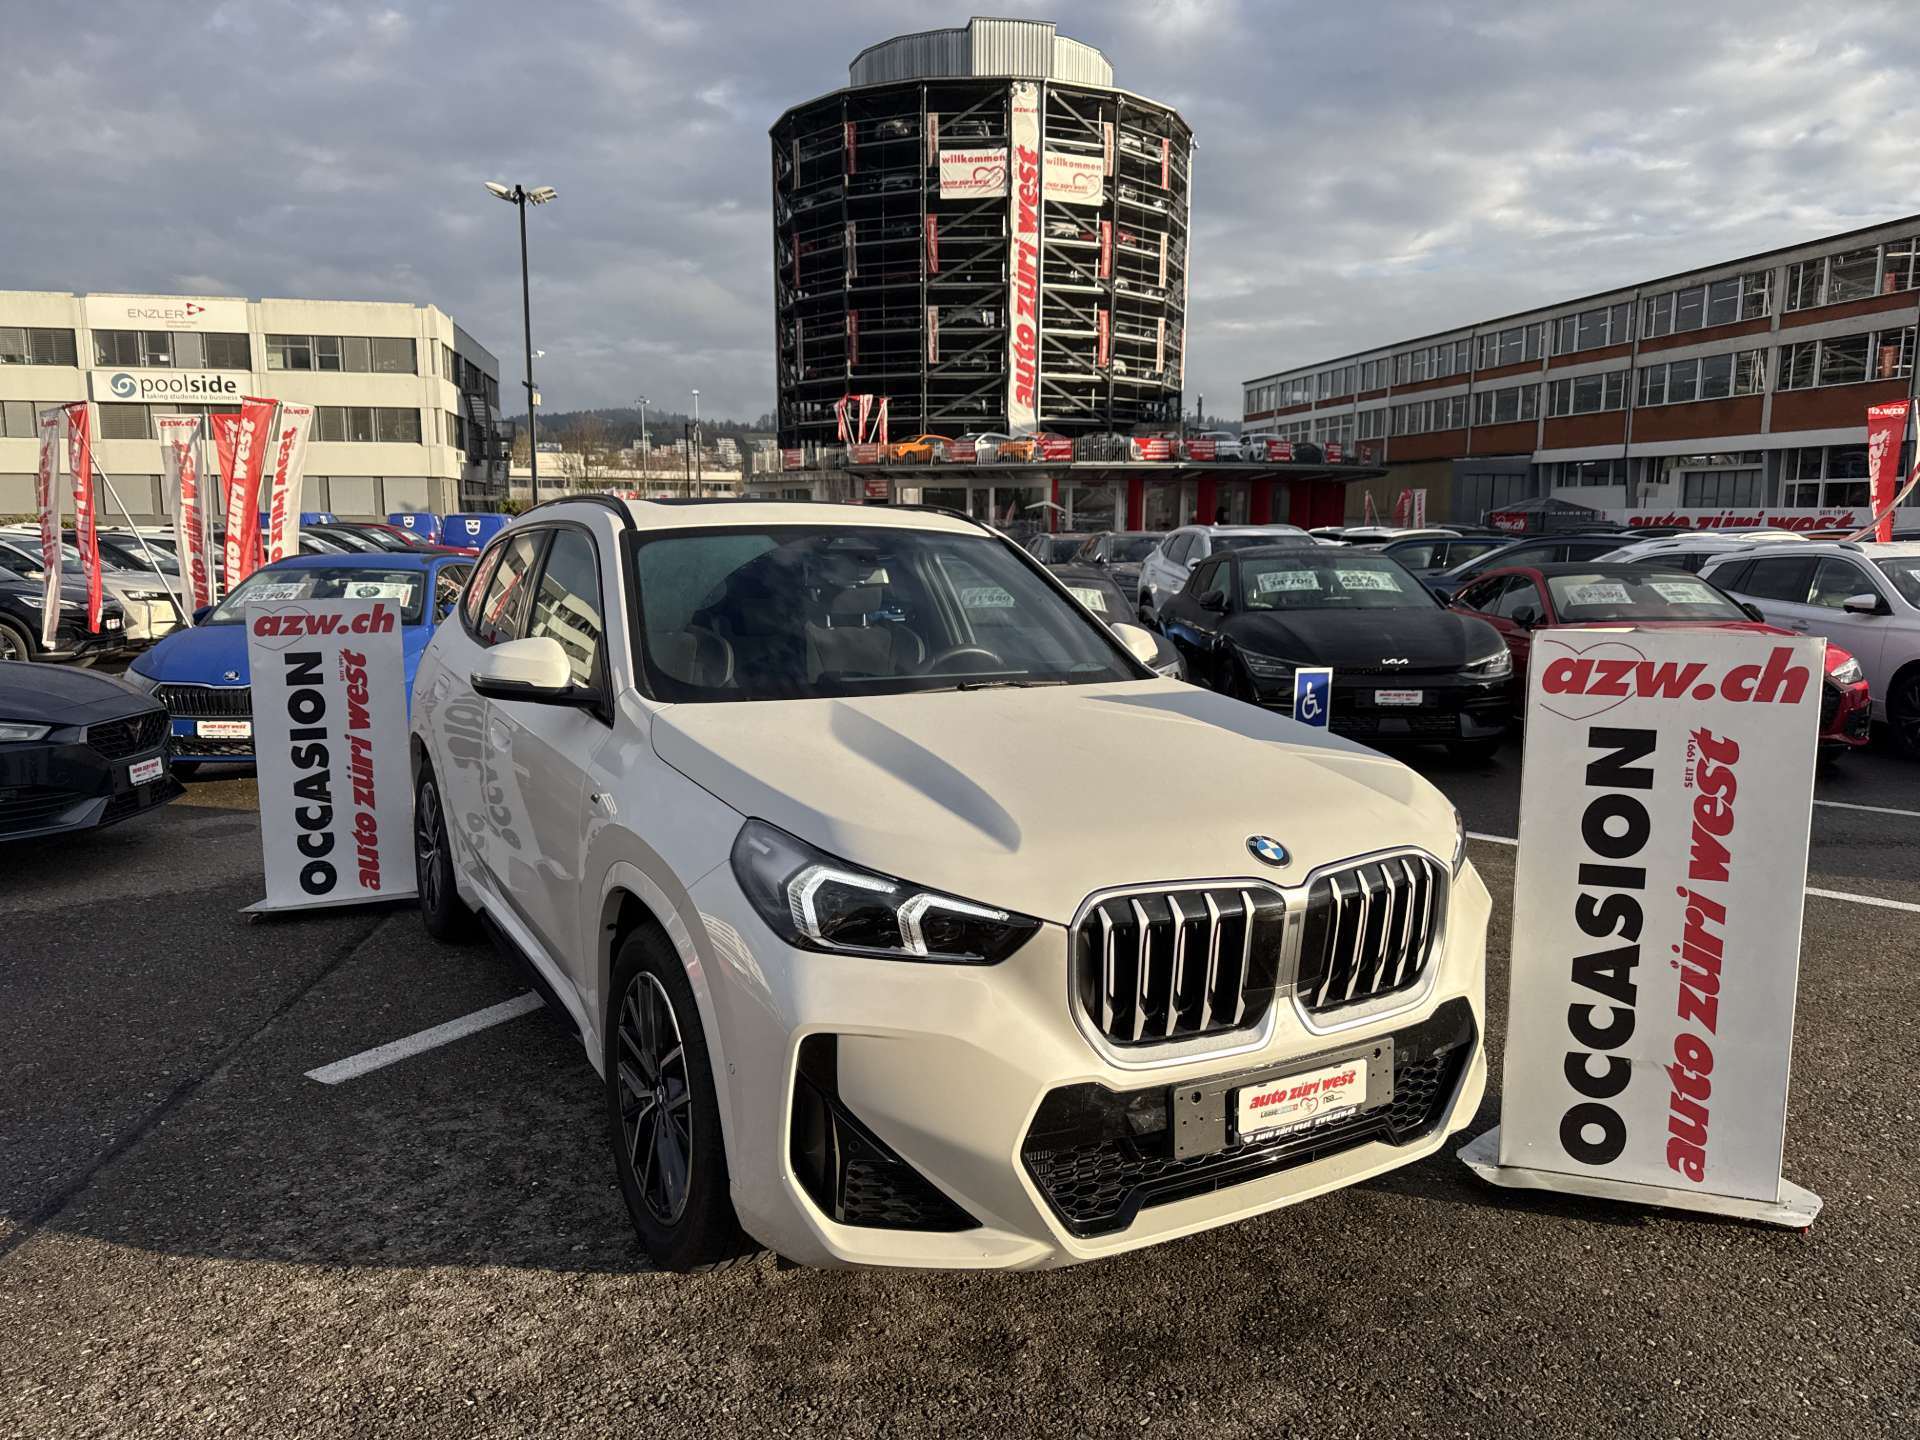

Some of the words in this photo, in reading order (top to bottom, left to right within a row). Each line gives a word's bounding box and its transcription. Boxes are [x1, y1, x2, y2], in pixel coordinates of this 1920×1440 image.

[942, 154, 1005, 163] willkommen
[1015, 144, 1039, 234] west
[1046, 157, 1101, 170] willkommen
[1013, 237, 1037, 318] züri
[127, 308, 184, 319] ENZLER
[140, 374, 236, 398] poolside
[170, 393, 199, 401] students
[1013, 328, 1035, 409] auto
[231, 416, 255, 480] west
[1628, 511, 1691, 528] auto
[1696, 510, 1764, 529] züri
[253, 603, 395, 637] azw.ch
[339, 648, 370, 730] west
[1541, 646, 1811, 705] azw.ch
[284, 651, 338, 896] OCCASION
[345, 734, 376, 810] züri
[1684, 766, 1695, 789] SEIT
[1686, 739, 1697, 763] 1991
[1687, 727, 1740, 883] west
[351, 811, 381, 891] auto
[1559, 726, 1658, 1166] OCCASION
[1670, 885, 1727, 1036] züri
[1249, 1088, 1287, 1109] auto
[1288, 1079, 1321, 1100] züri
[1322, 1070, 1356, 1091] west
[1666, 1032, 1715, 1184] auto
